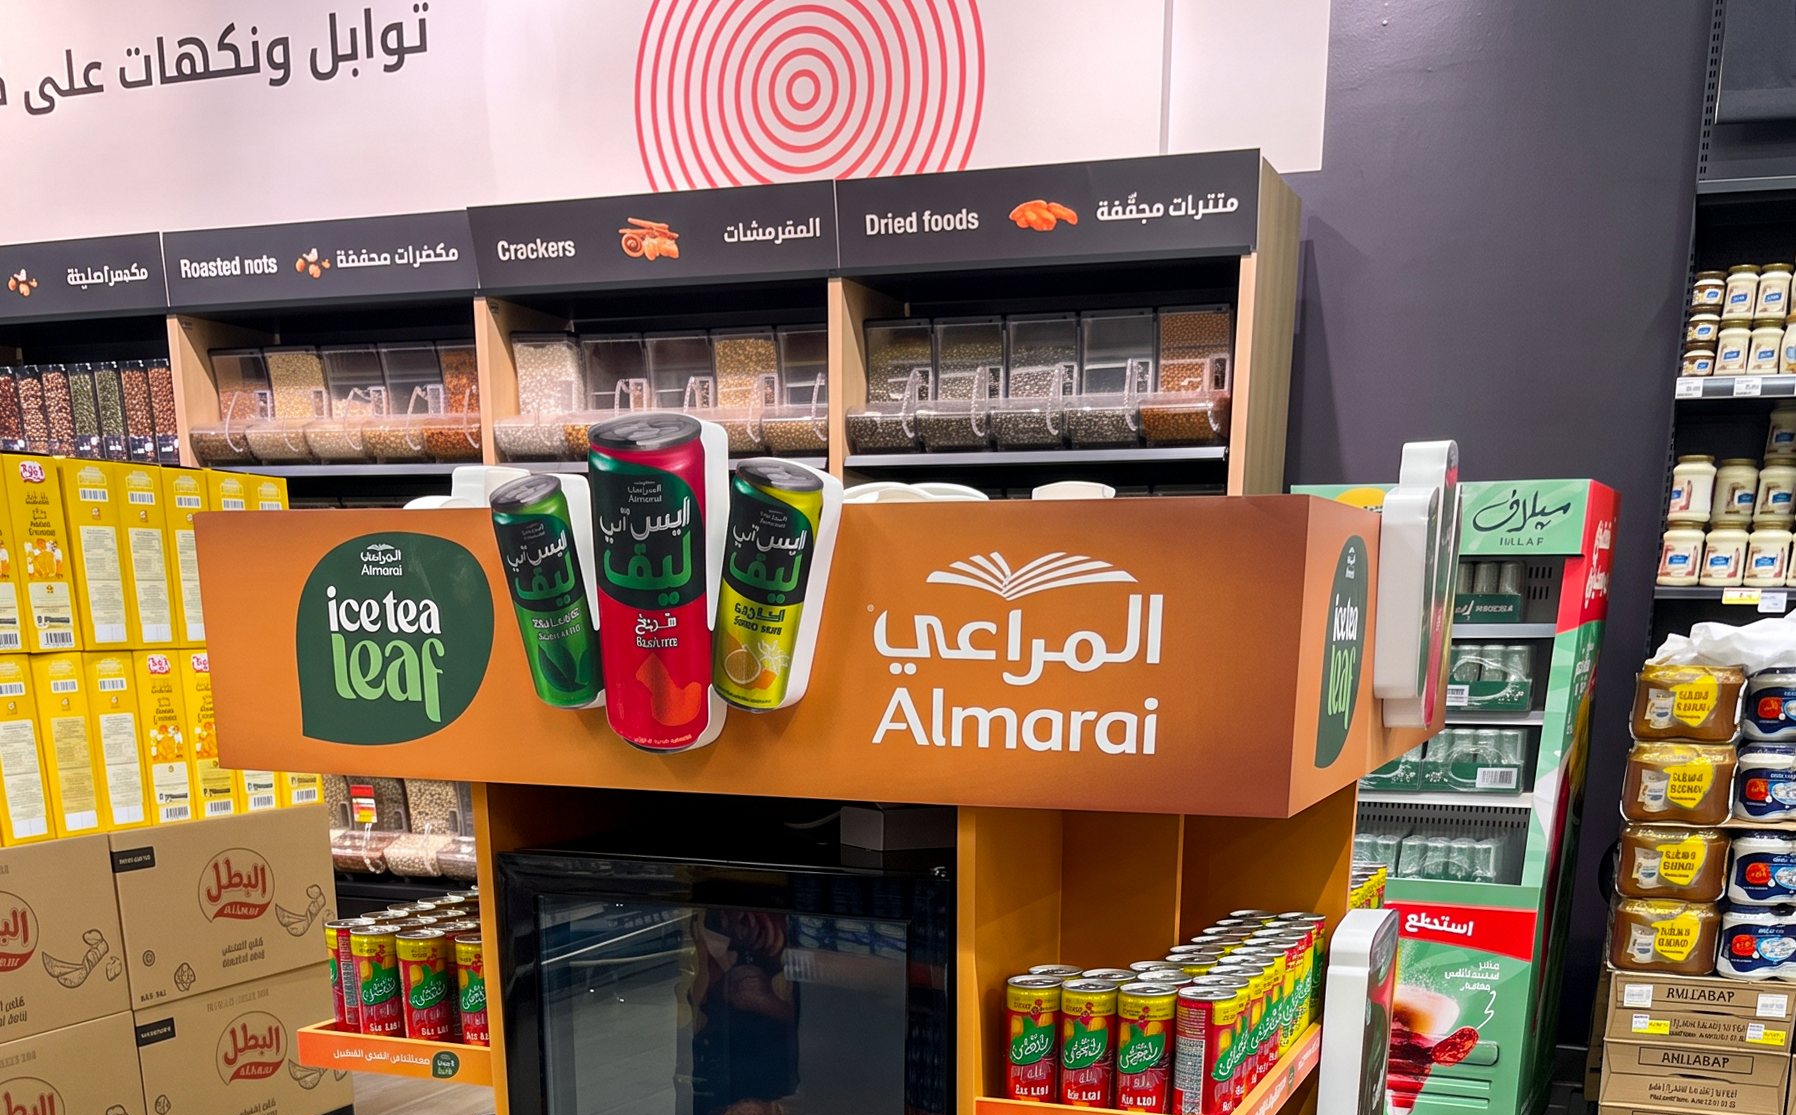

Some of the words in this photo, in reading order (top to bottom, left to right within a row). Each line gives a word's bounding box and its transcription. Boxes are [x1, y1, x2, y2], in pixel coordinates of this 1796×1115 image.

[118, 22, 291, 90] ونكهات
[310, 2, 430, 82] توابل
[24, 48, 104, 116] على
[497, 238, 576, 261] Crackers
[723, 217, 821, 245] المقرمشات
[864, 212, 917, 236] Dried
[922, 208, 979, 232] foods
[180, 255, 241, 280] Roasted
[244, 254, 278, 276] nots
[361, 564, 403, 576] Almarai
[873, 594, 1164, 686] المراعي
[331, 633, 445, 723] leaf
[871, 687, 1160, 755] Almarai
[223, 1022, 280, 1066] البطل
